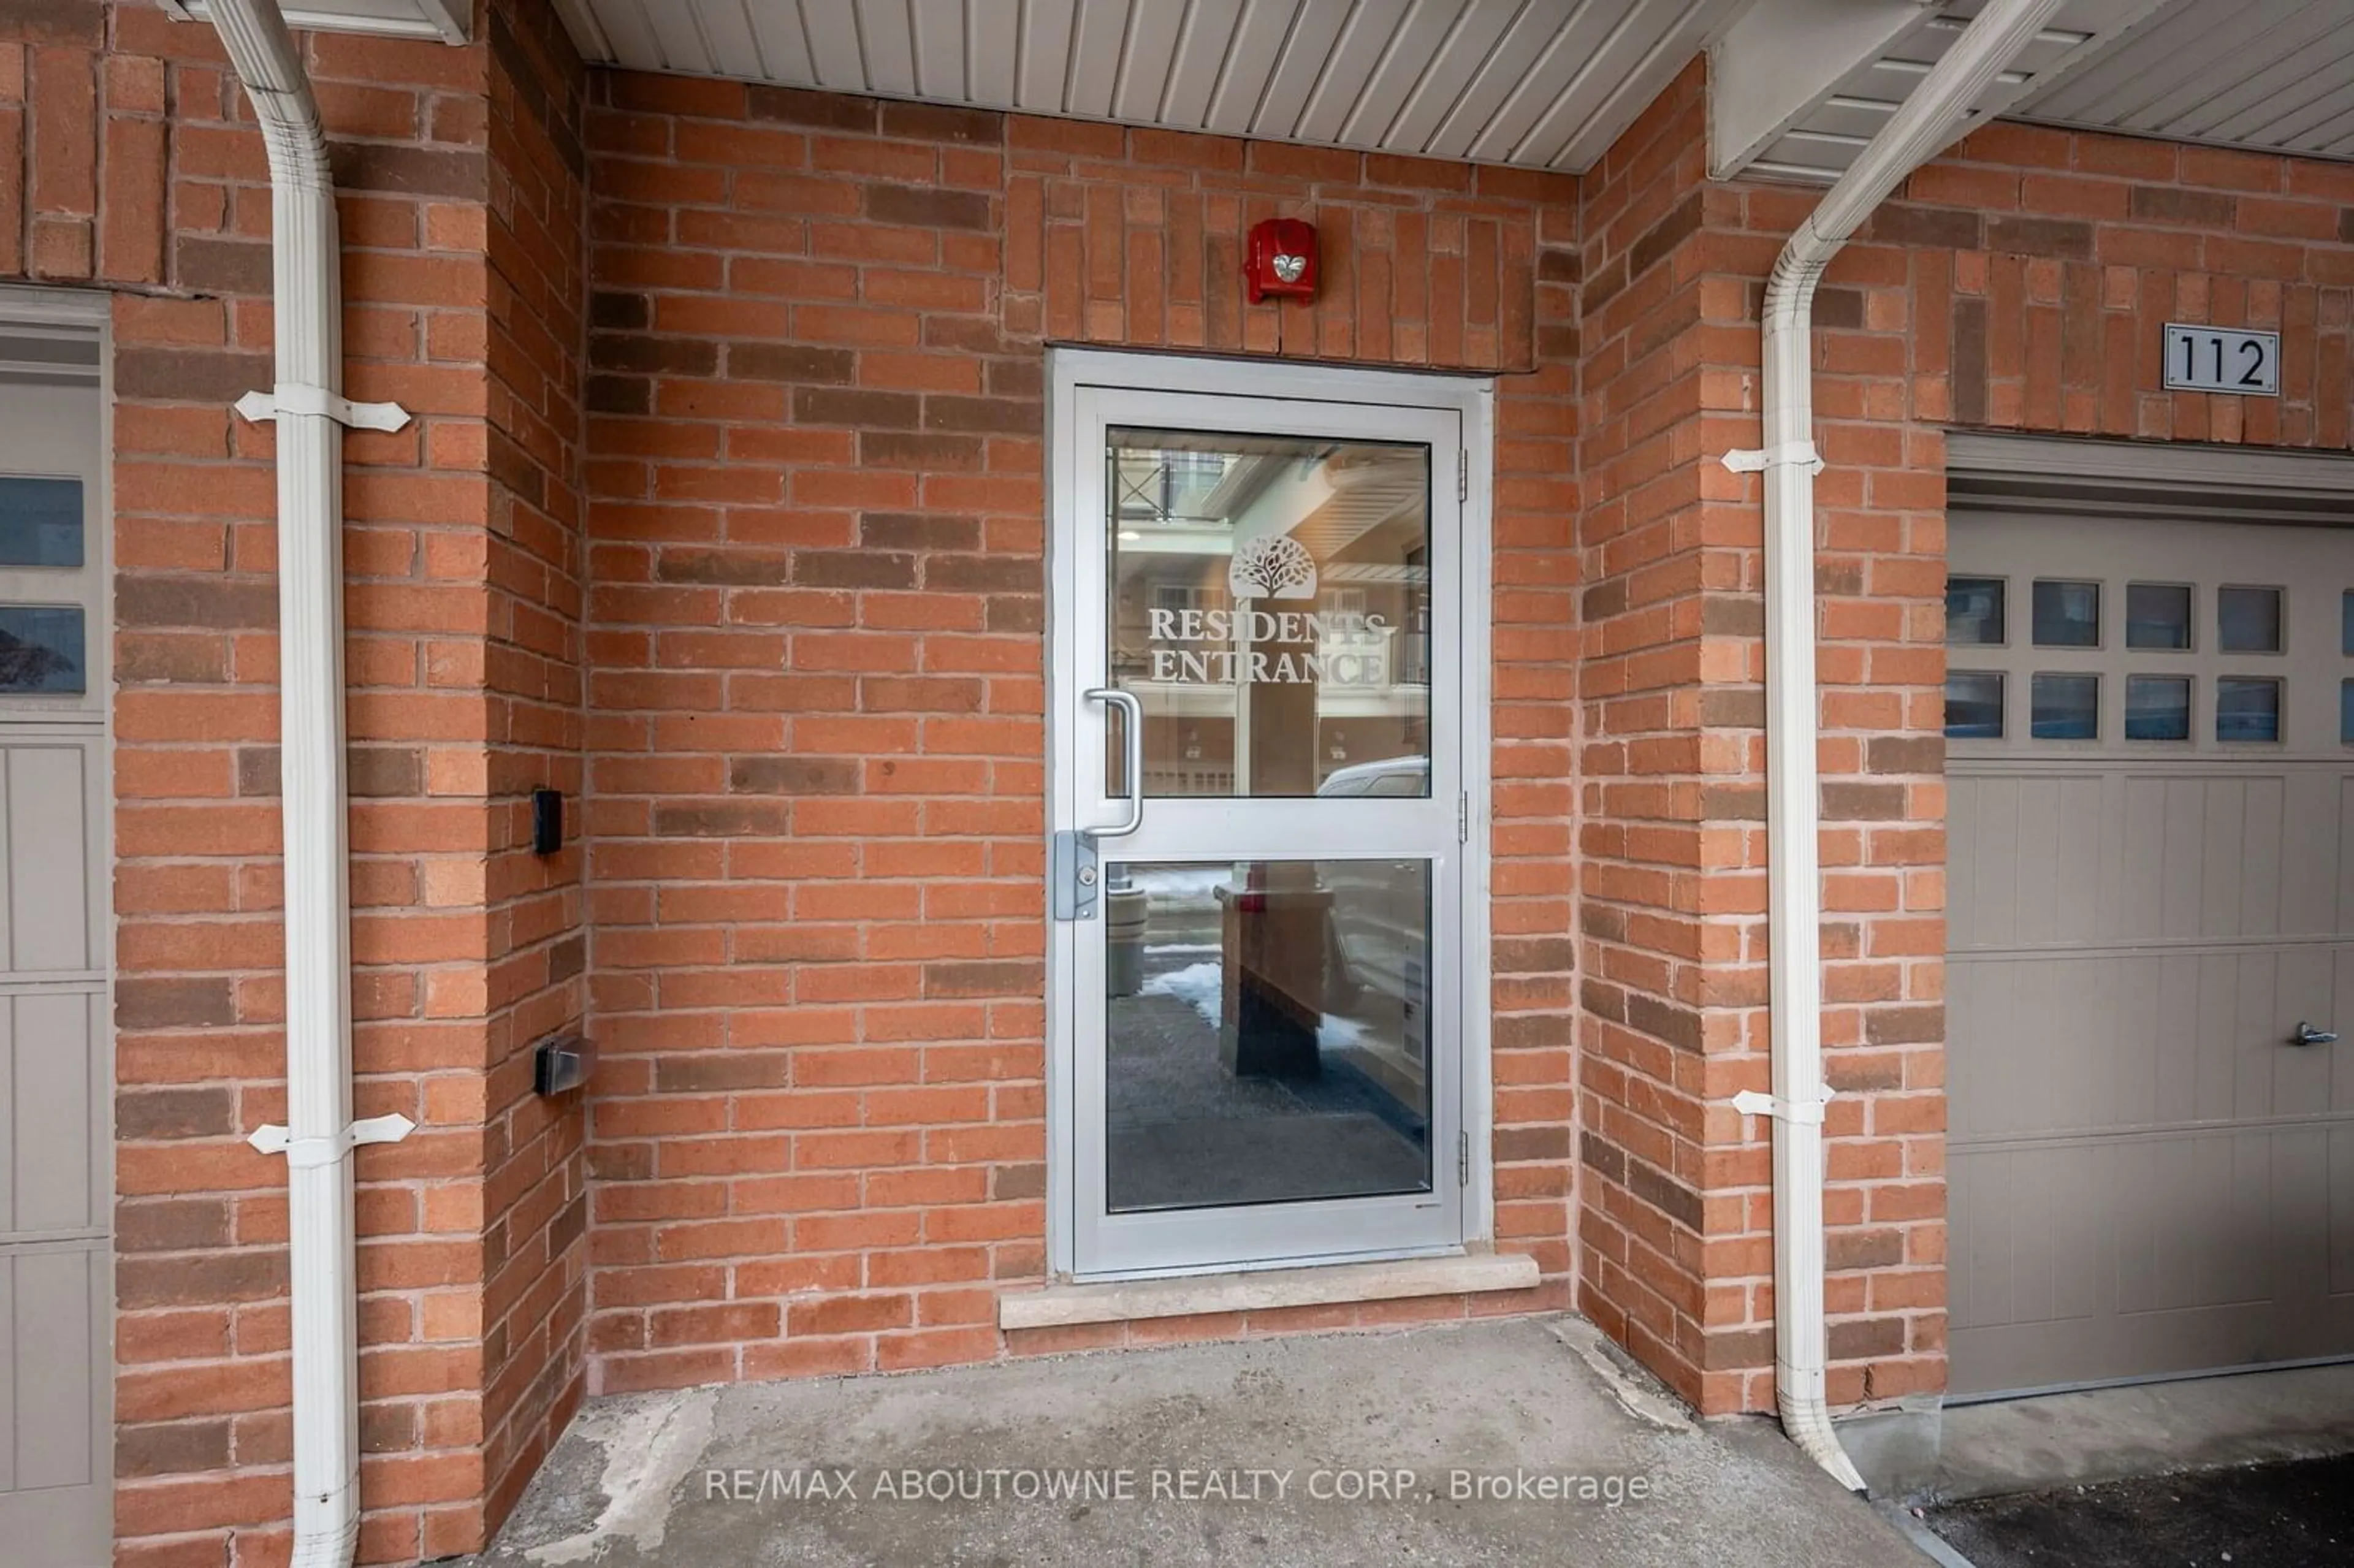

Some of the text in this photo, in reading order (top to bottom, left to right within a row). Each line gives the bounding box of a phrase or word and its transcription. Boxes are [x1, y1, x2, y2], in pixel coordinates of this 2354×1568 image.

[2181, 335, 2264, 386] 112
[1149, 608, 1387, 645] RESIDENTS
[1151, 649, 1384, 685] ENTRANCE
